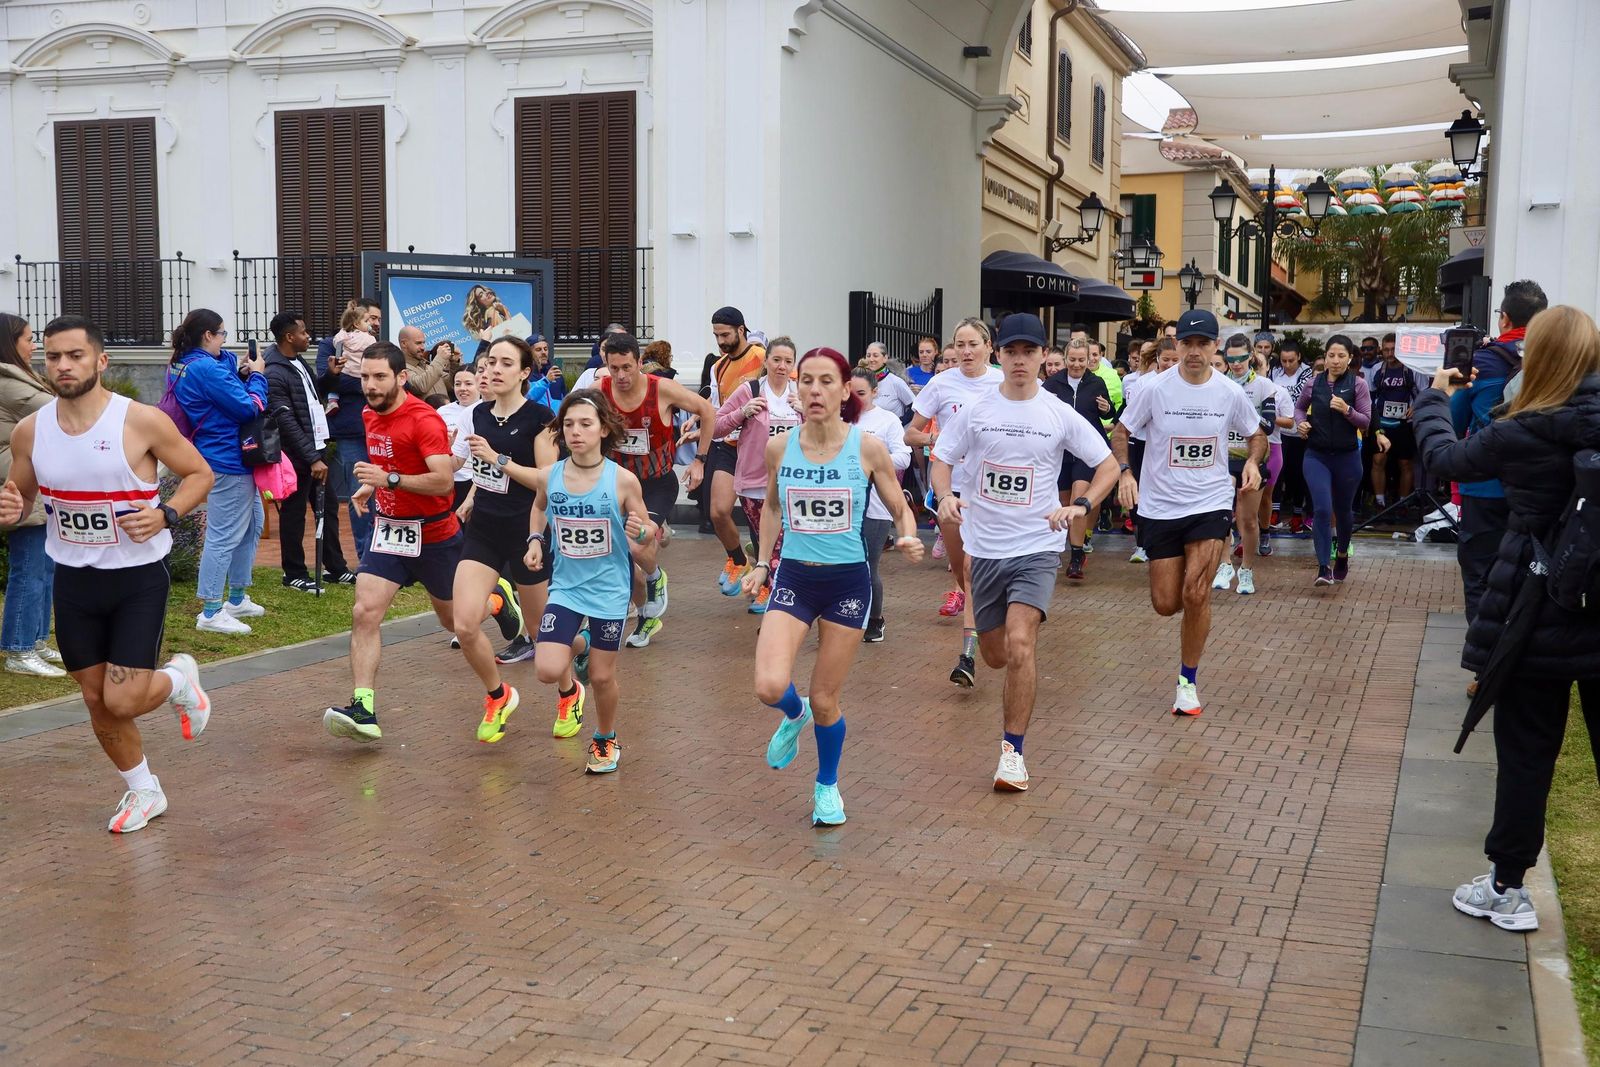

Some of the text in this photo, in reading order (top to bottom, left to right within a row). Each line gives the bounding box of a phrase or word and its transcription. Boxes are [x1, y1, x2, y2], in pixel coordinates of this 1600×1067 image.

[1026, 275, 1072, 293] TOMMY
[403, 294, 452, 317] BIENVENIDO
[406, 308, 440, 325] WELCOME
[1175, 444, 1213, 458] 188
[780, 465, 842, 484] nerja
[986, 472, 1028, 492] 189
[794, 500, 844, 517] 163
[58, 510, 109, 531] 206
[381, 524, 417, 544] 118
[561, 528, 605, 545] 283
